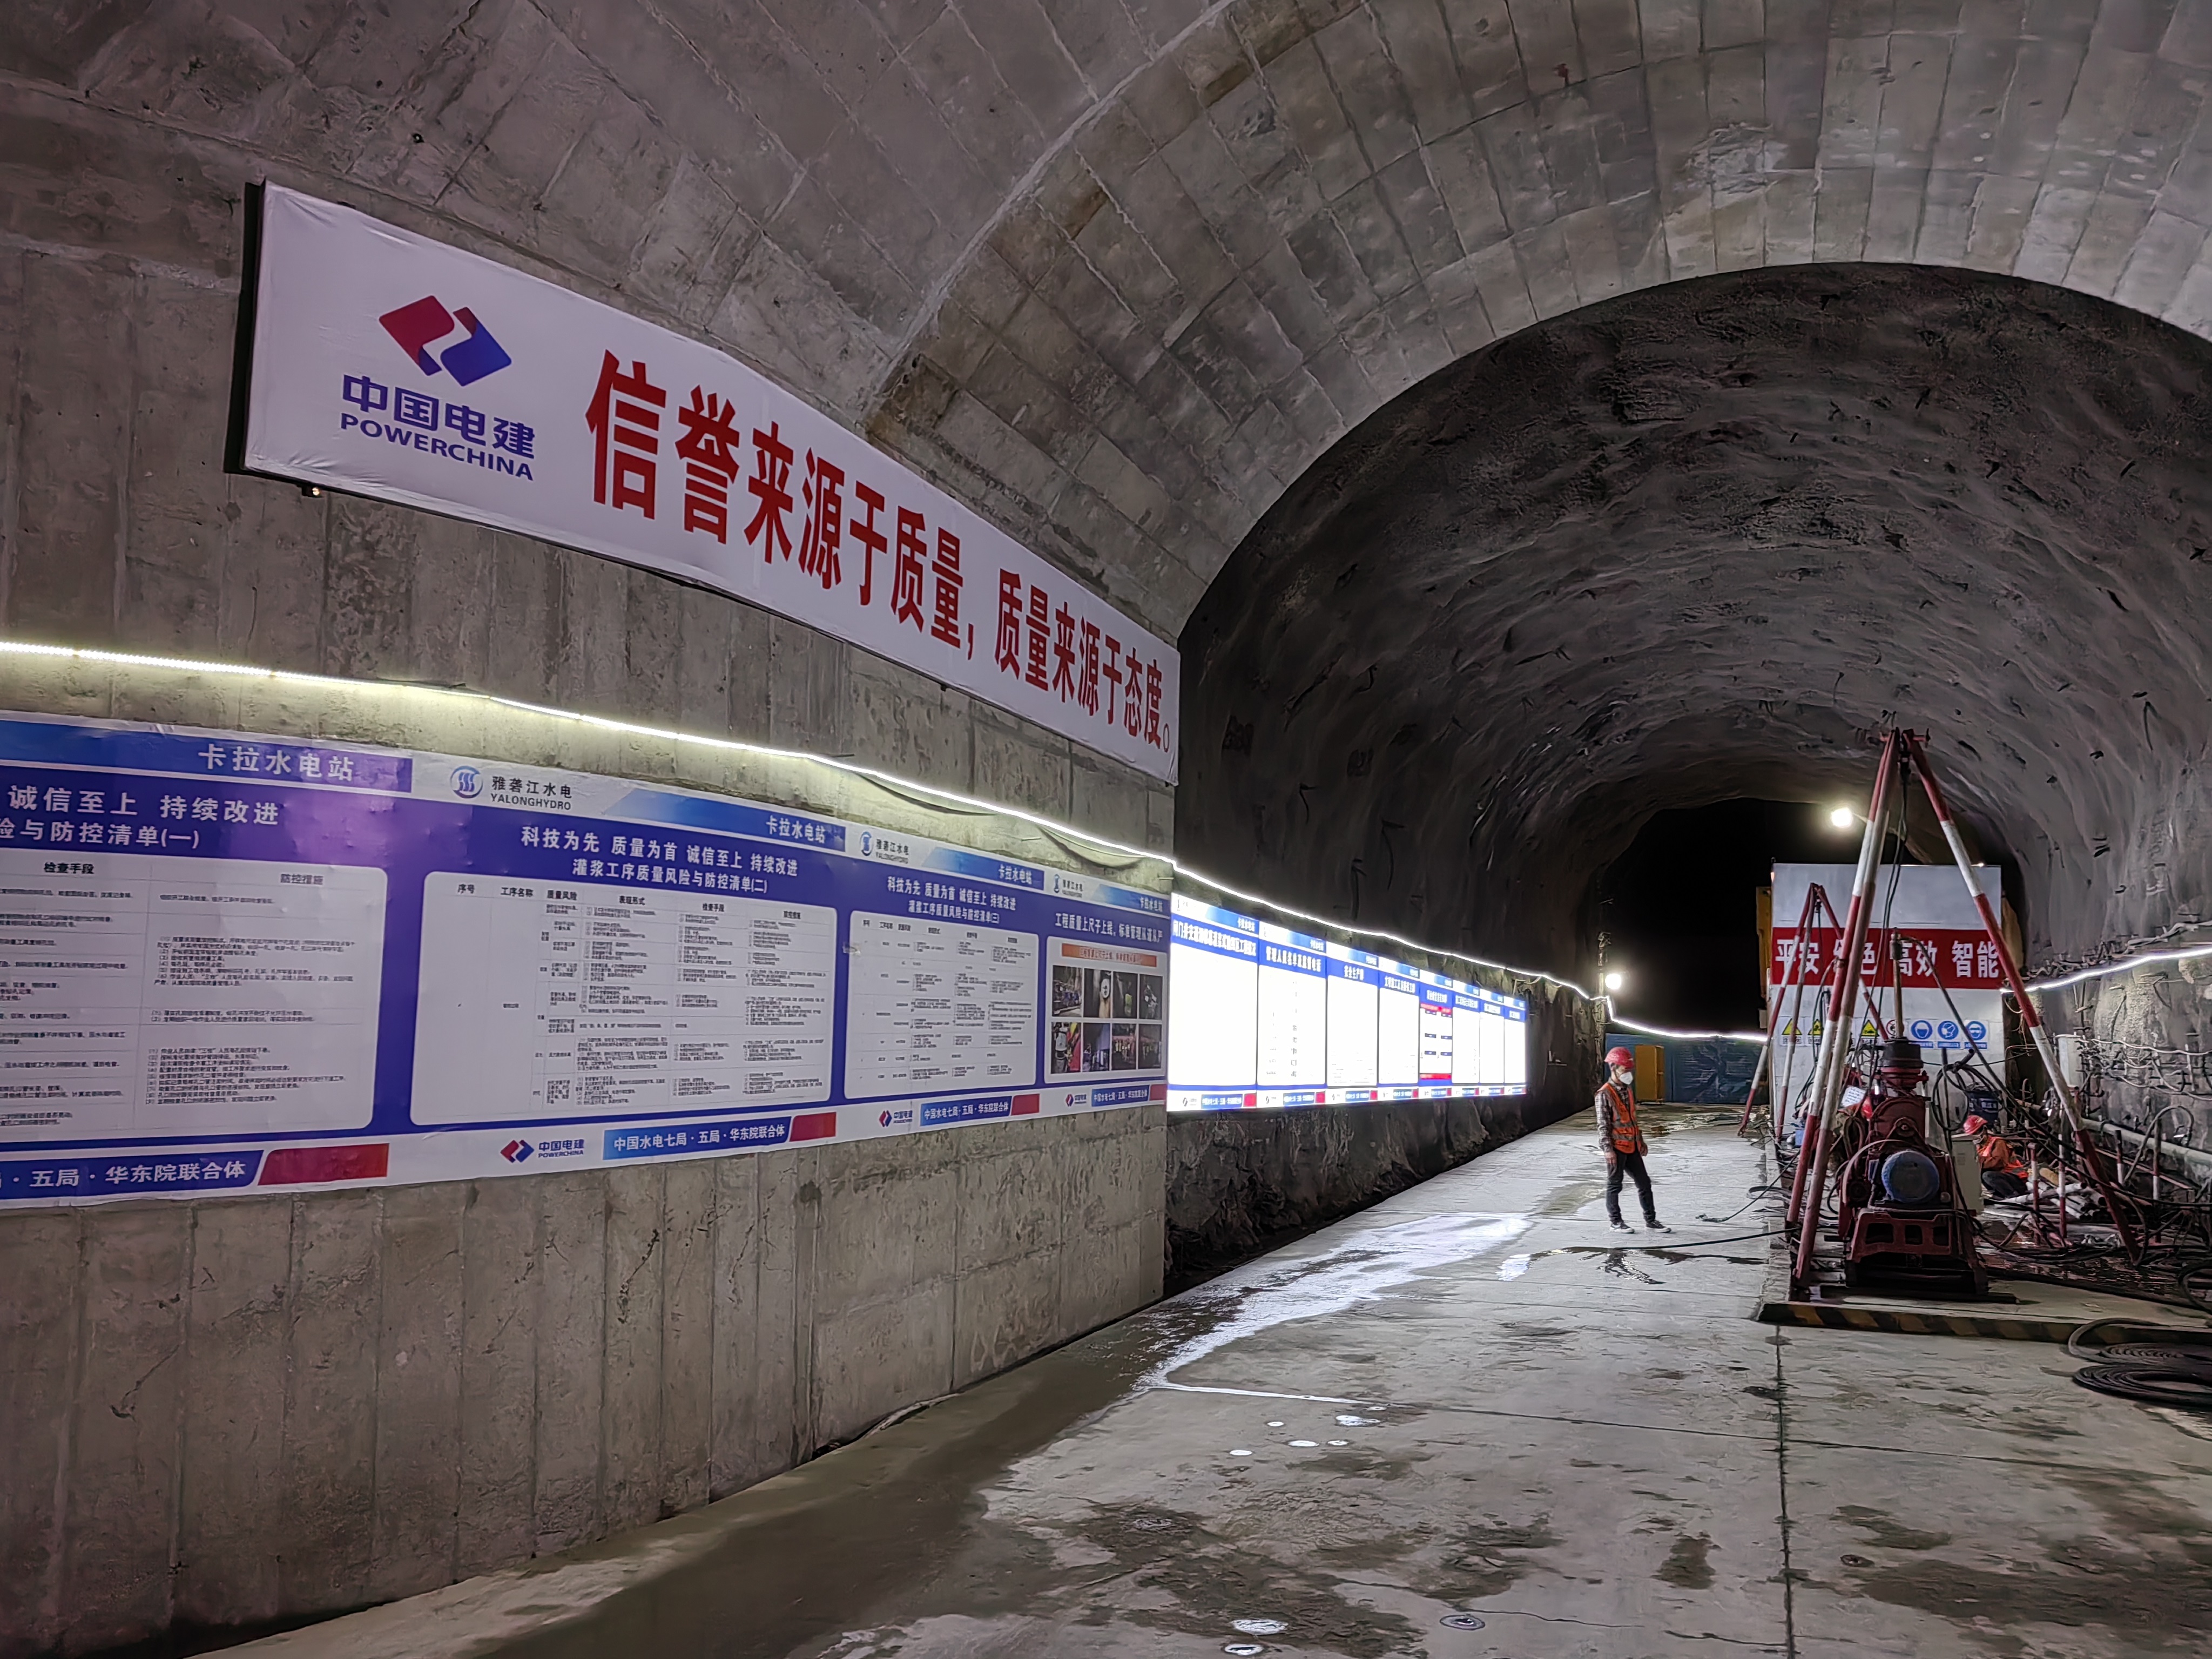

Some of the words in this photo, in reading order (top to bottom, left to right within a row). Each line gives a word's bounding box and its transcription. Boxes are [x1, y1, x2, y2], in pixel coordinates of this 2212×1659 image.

[342, 374, 535, 458] 中国电建
[341, 413, 534, 481] POWERCHINA
[198, 743, 354, 781] 卡拉水电站
[492, 775, 572, 799] 雅砻江水电
[8, 785, 138, 815] 诚信至上
[160, 794, 279, 825] 持续改进
[491, 794, 571, 811] YALONGHYDRO
[766, 815, 826, 844] 卡拉水电站
[521, 826, 600, 853] 科技为先
[611, 835, 678, 862] 质量为首
[686, 844, 743, 869] 诚信至上
[750, 853, 798, 877] 持续改进
[44, 862, 95, 874] 检查手段
[998, 864, 1033, 885] 卡拉水电站
[457, 884, 475, 894] 序号
[500, 887, 534, 898] 工序名称
[547, 890, 577, 901] 质量风险
[887, 876, 921, 895] 科技为先
[925, 882, 955, 901] 质量为首
[1775, 939, 1820, 974] 平安
[1952, 940, 1999, 978] 智能
[538, 1139, 584, 1151] 中国电建
